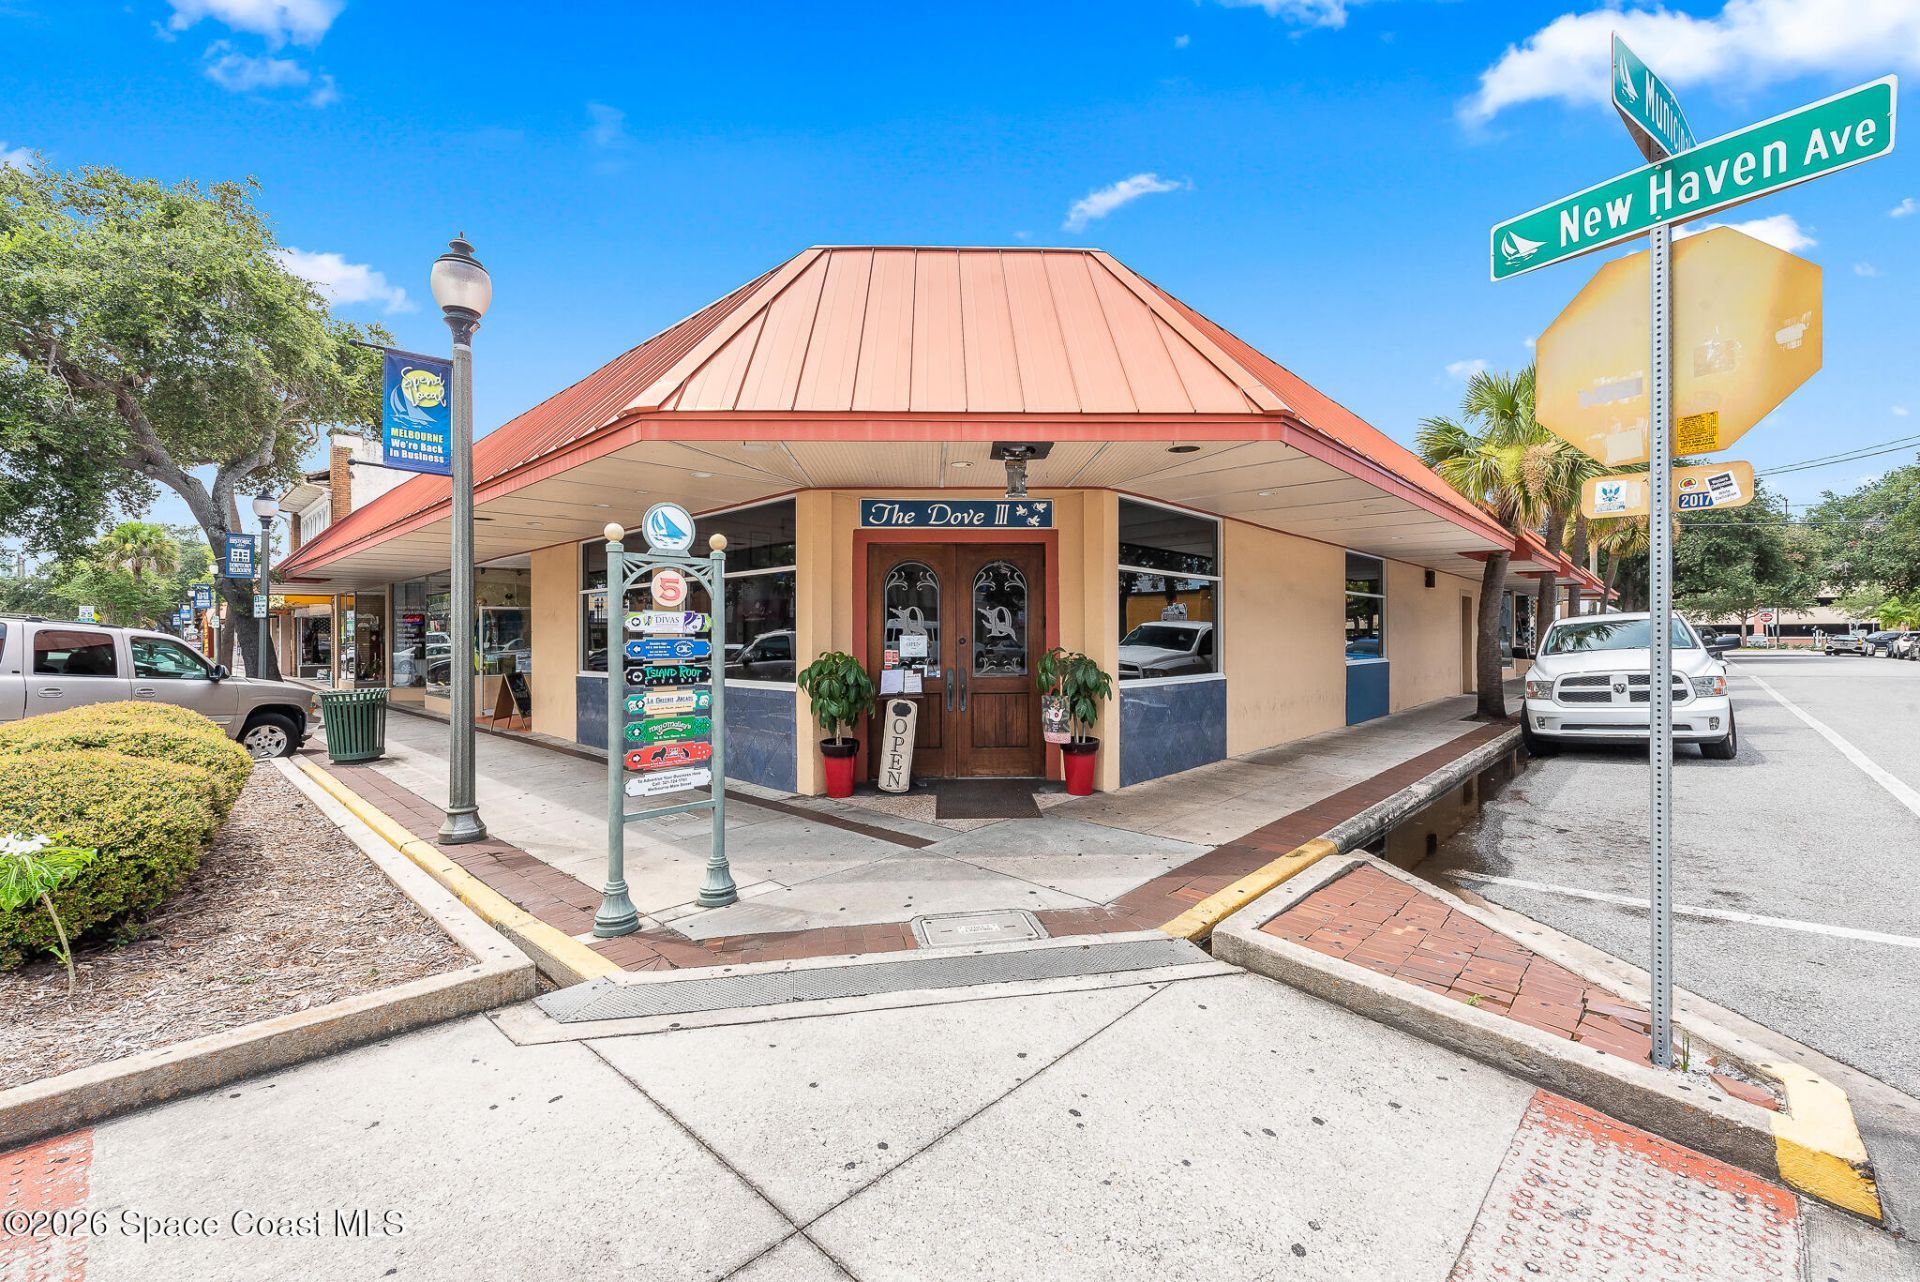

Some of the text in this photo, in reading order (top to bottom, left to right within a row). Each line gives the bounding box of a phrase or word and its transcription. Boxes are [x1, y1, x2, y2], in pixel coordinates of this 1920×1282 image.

[1559, 117, 1877, 248] New Haven Ave
[401, 366, 445, 391] Spend
[408, 386, 447, 407] Local
[390, 427, 444, 443] MELBOURNE
[391, 438, 443, 454] We're Back
[401, 450, 445, 464] Business
[1681, 493, 1711, 508] 2017
[869, 503, 916, 525] The
[928, 503, 985, 525] Dove
[660, 577, 681, 601] 5
[655, 616, 680, 624] DIVAS
[886, 718, 907, 788] OPEN
